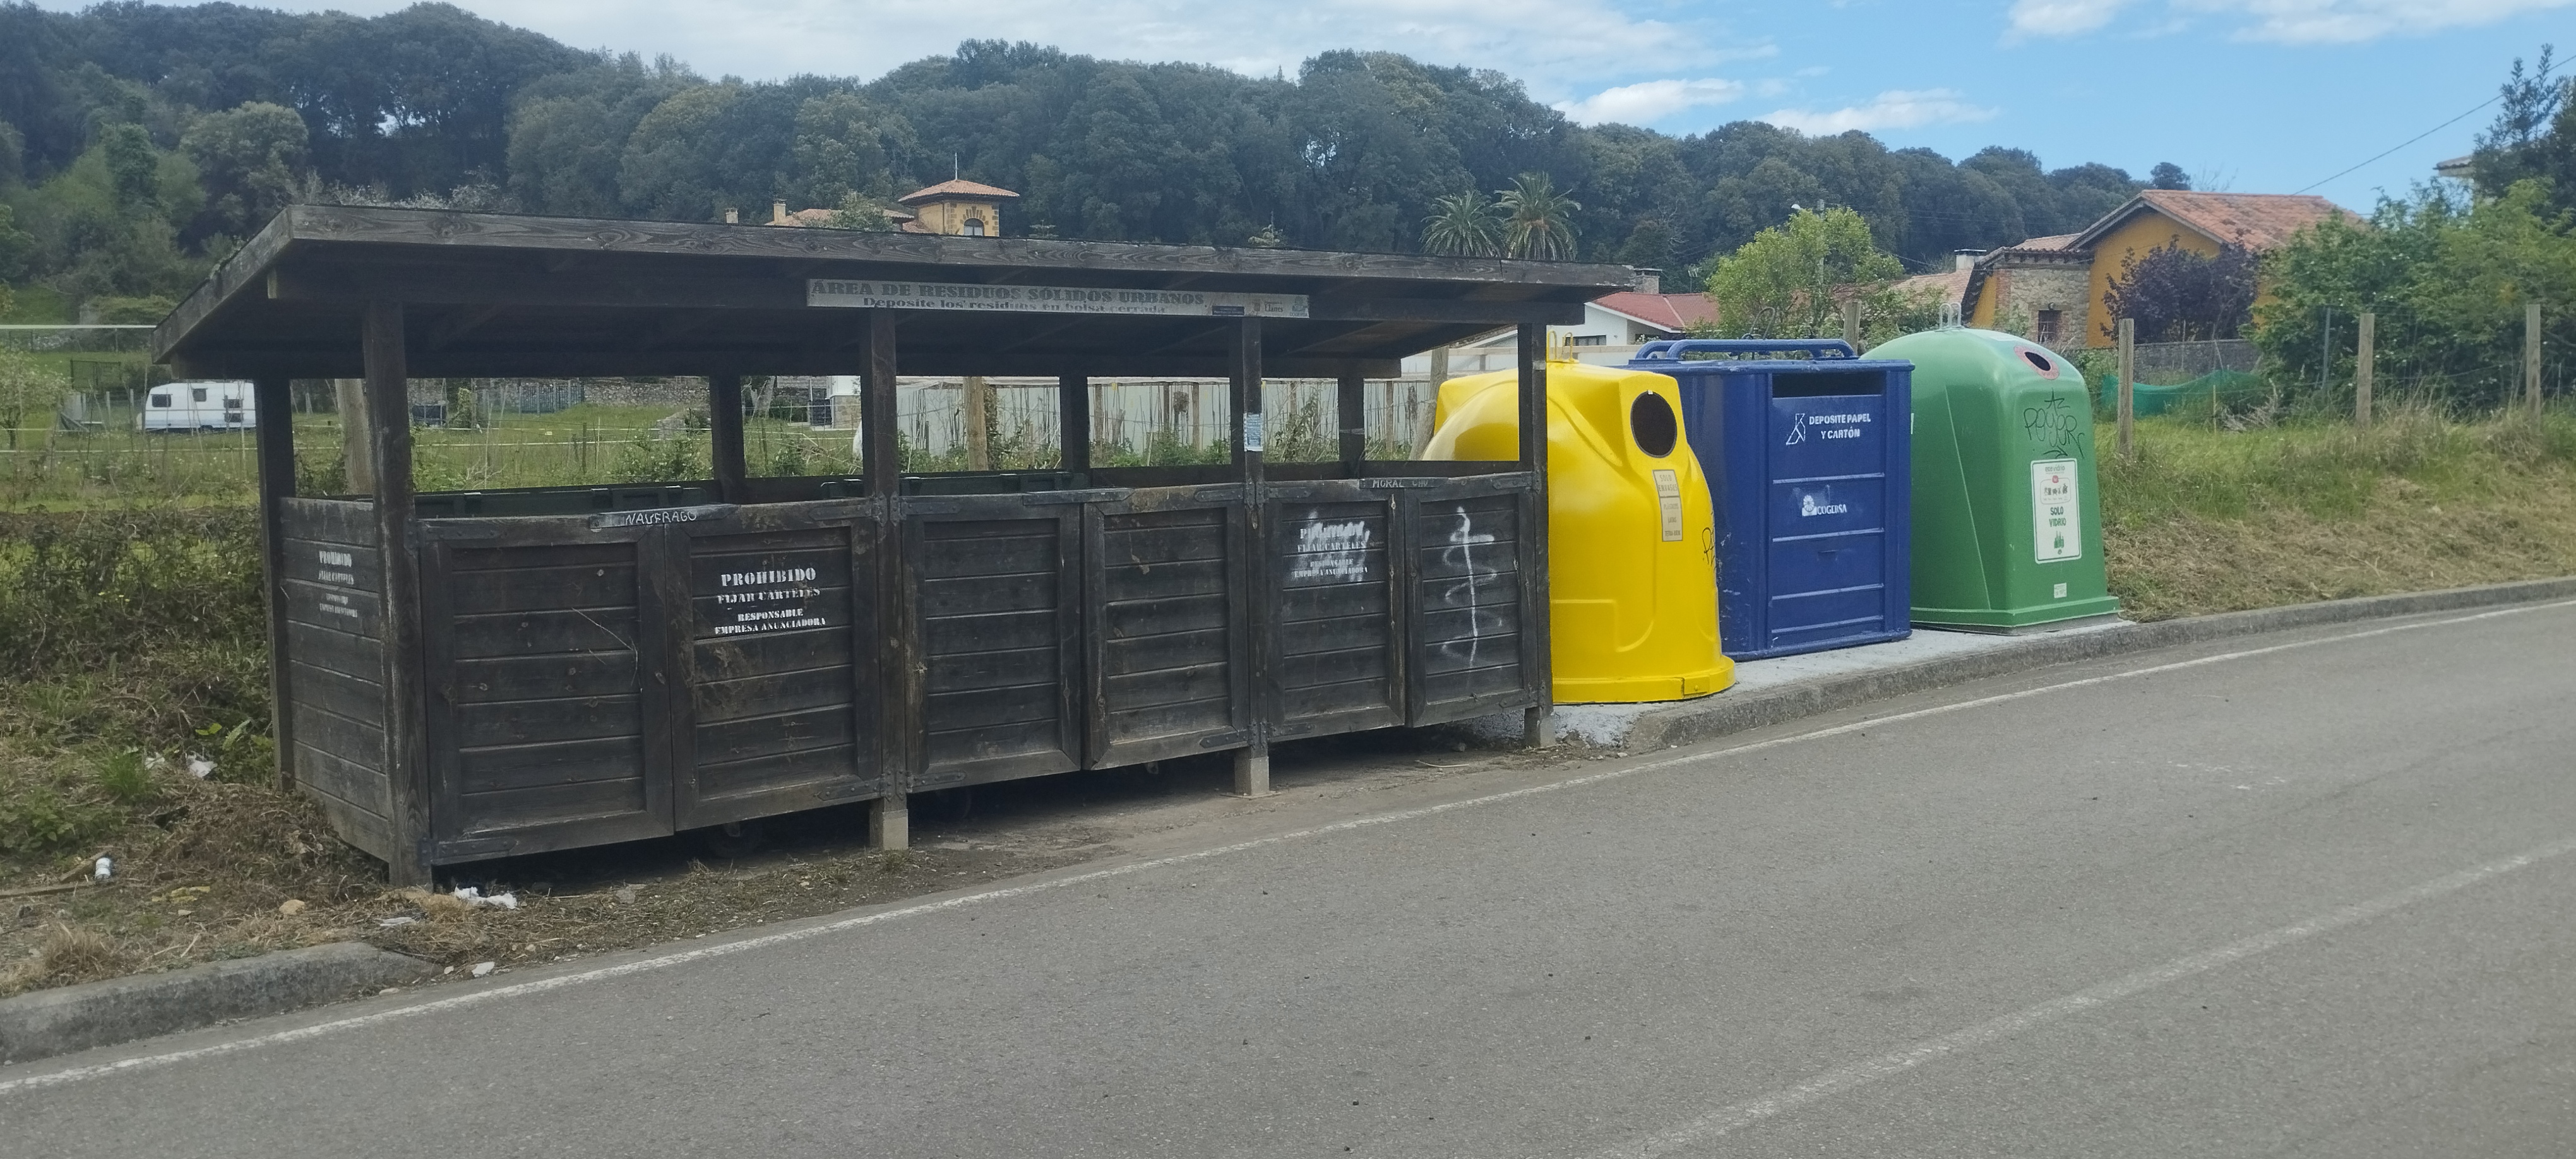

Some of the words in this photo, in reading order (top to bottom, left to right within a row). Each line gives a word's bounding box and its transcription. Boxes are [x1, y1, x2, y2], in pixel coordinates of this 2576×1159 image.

[811, 280, 874, 295] ÁREA
[882, 284, 911, 295] DE
[919, 285, 1021, 299] RESIDUOS
[1028, 287, 1112, 302] SÓLIDOS
[1119, 291, 1204, 304] URBANOS
[864, 297, 934, 308] Deposite
[941, 300, 963, 308] los
[1809, 415, 1847, 425] DEPOSITE
[1847, 413, 1871, 423] PAPEL
[1821, 431, 1827, 439] Y
[1827, 426, 1860, 439] CARTÓN
[1817, 504, 1847, 515] COGERSA
[2050, 506, 2064, 516] SOLO
[626, 511, 696, 525] NAUFRAGO
[2049, 518, 2066, 527] VIDRIO
[721, 568, 816, 586] PROHIBIDO
[717, 593, 754, 604] FIJAR
[758, 588, 821, 600] CARTELES
[737, 609, 804, 622] RESPONSABLE
[714, 624, 759, 635] EMPRESA
[761, 617, 826, 631] ANUNCIADORA
